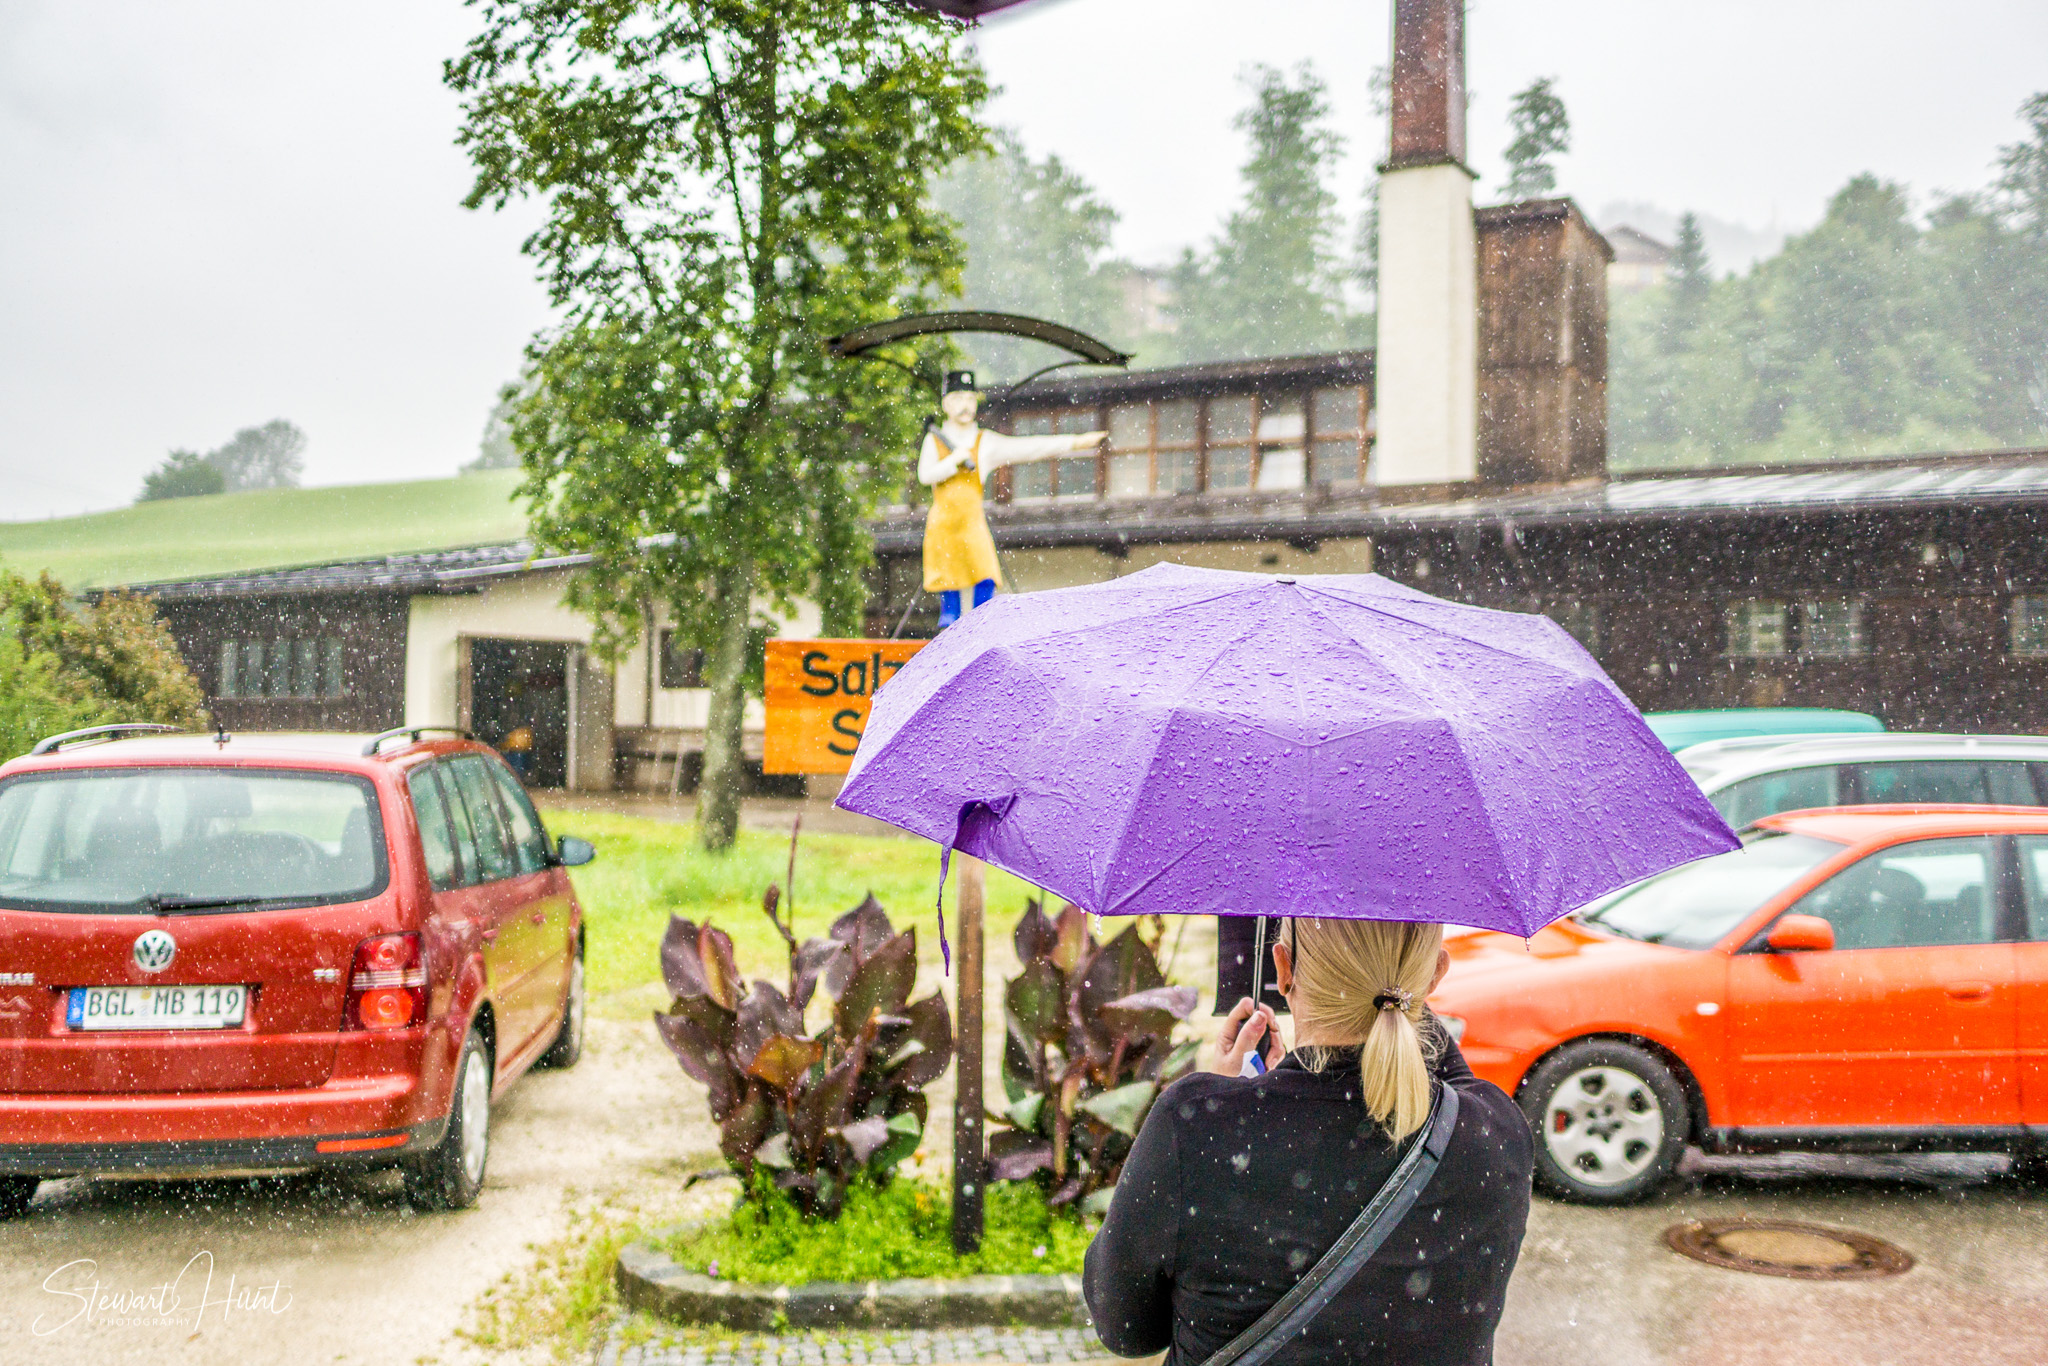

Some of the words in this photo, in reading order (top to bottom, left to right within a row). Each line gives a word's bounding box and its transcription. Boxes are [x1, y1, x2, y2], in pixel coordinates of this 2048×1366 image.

[88, 989, 134, 1016] BGL
[154, 987, 185, 1015] MB
[192, 987, 239, 1015] 119
